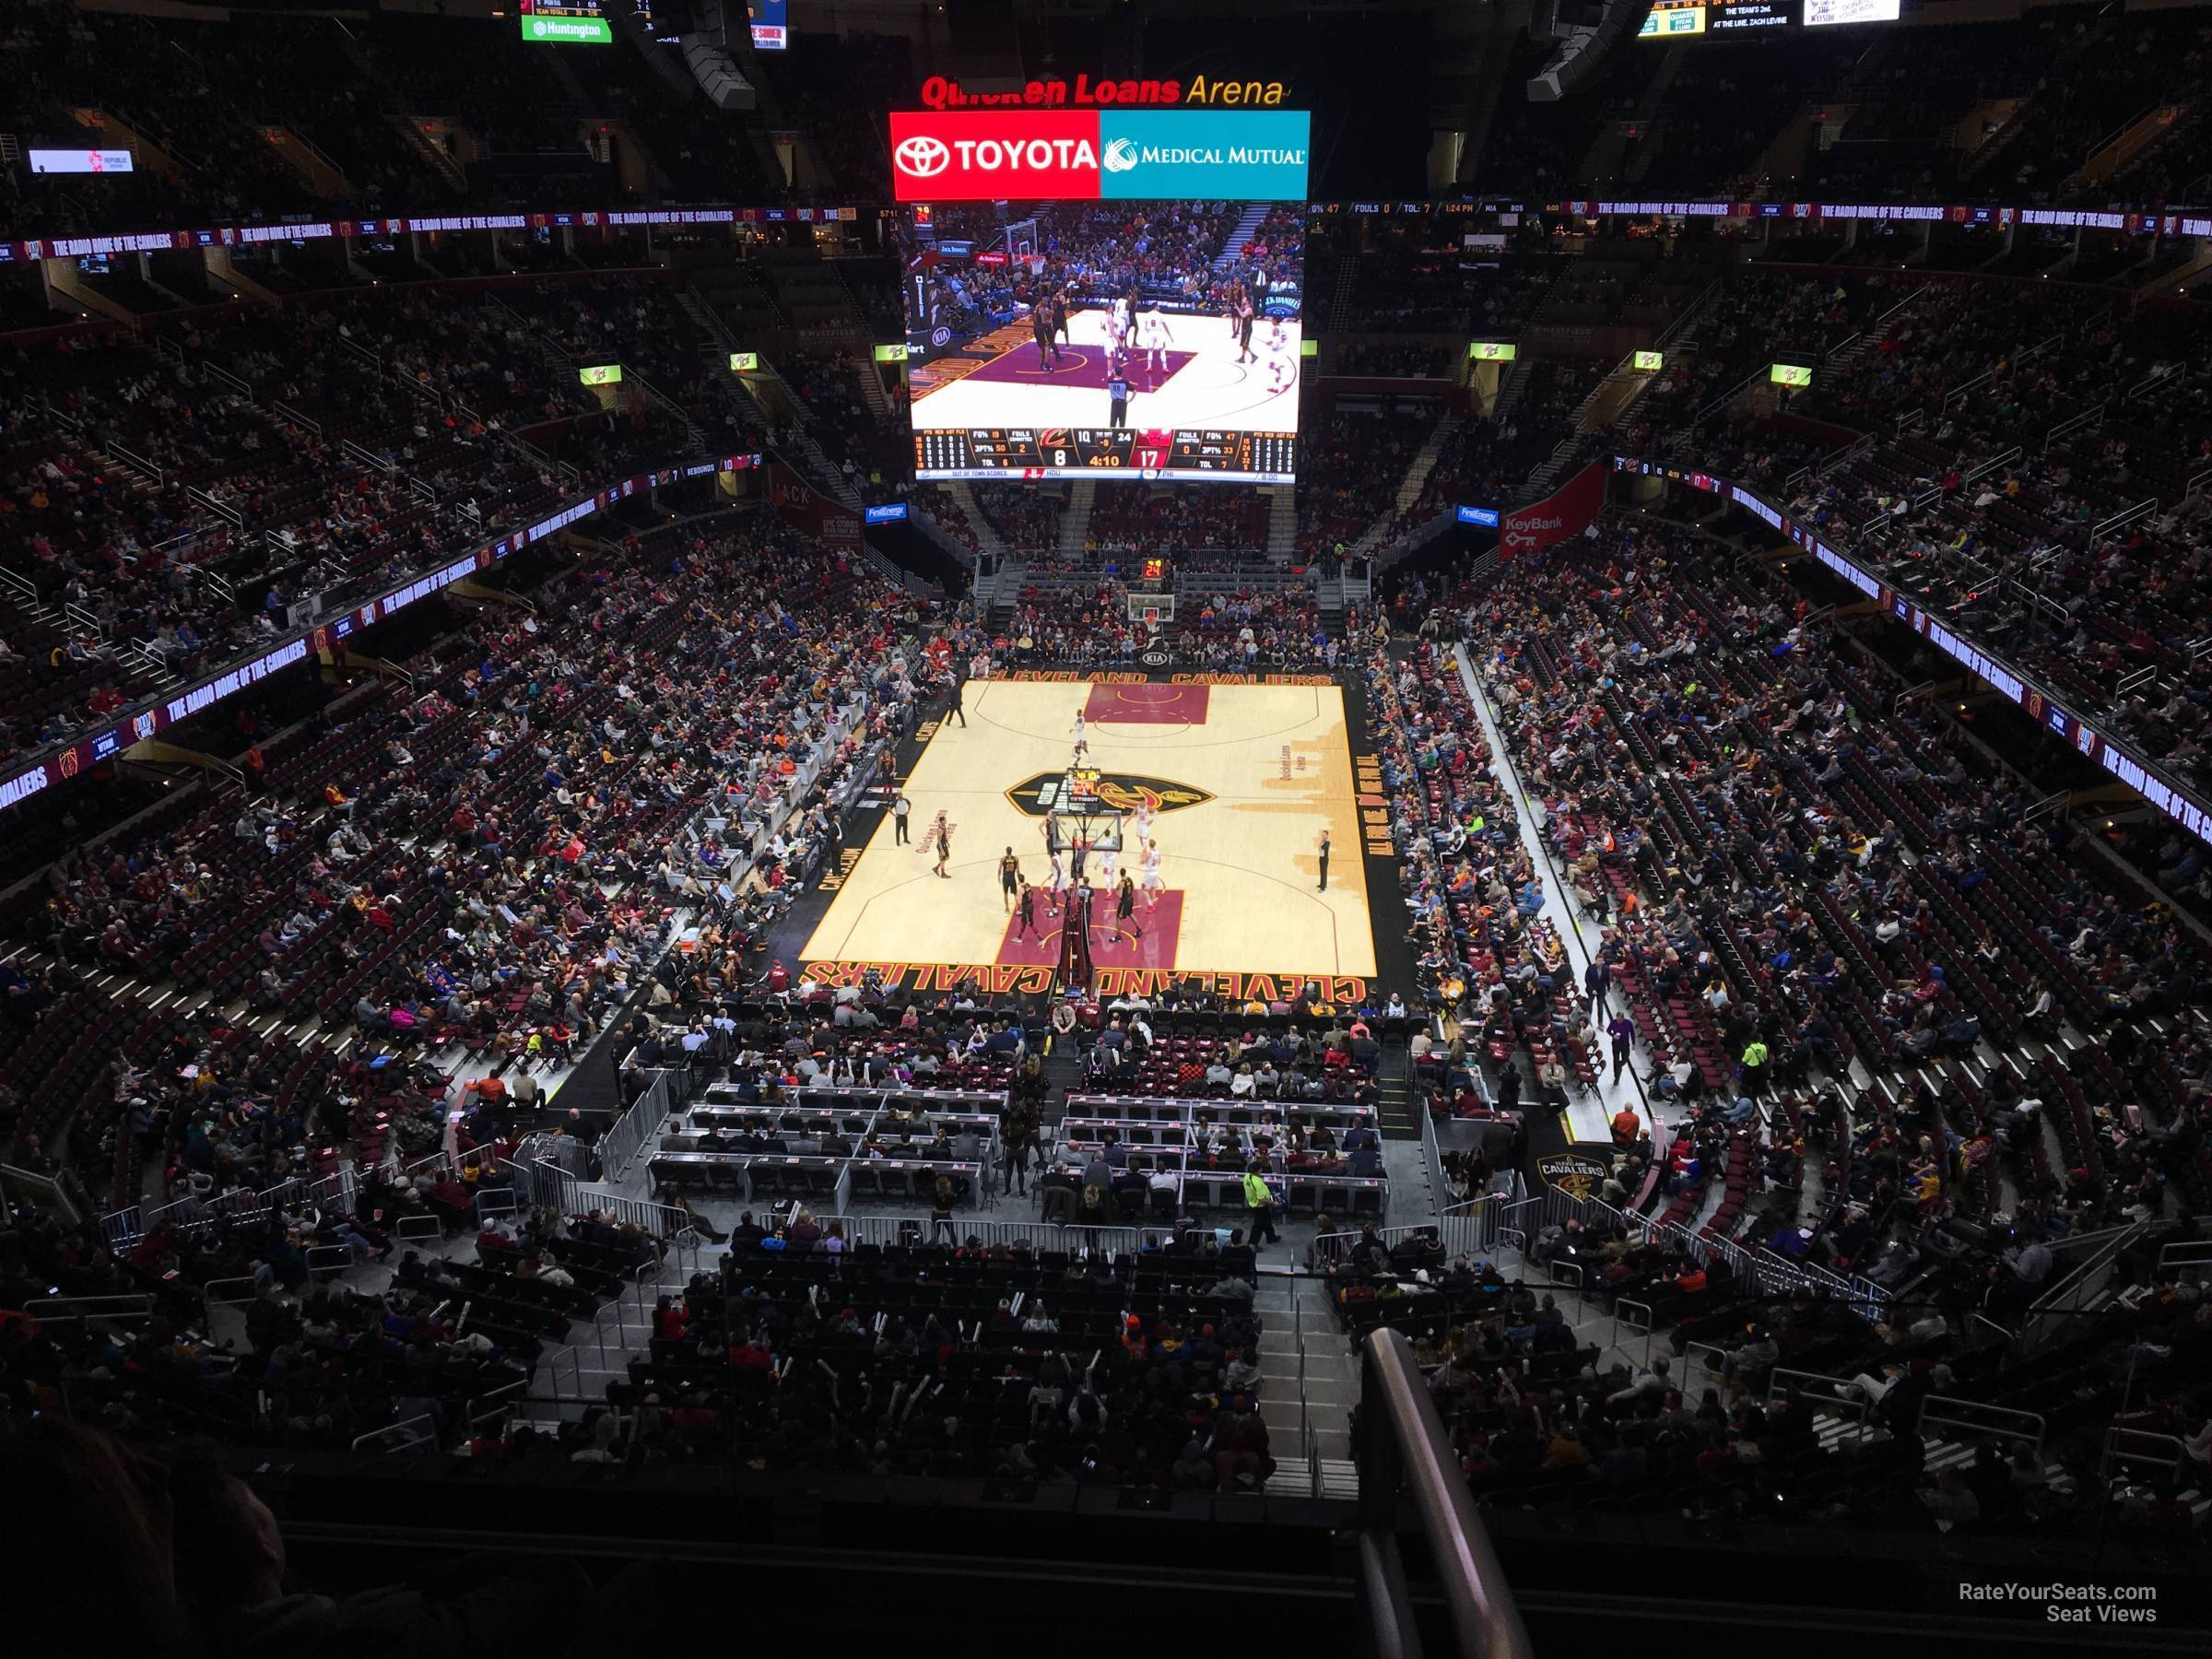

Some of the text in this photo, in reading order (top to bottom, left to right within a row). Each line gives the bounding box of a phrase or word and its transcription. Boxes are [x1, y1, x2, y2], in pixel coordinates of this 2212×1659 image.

[1670, 11, 1695, 20] QUAKER
[1750, 18, 1765, 26] ZACH
[1767, 16, 1787, 25] LEVINE
[547, 21, 600, 38] Huntington
[922, 74, 1283, 110] Quen Loans Arena
[954, 140, 1097, 170] TOYOTA
[1141, 146, 1302, 165] MEDICAL MUTUAL
[824, 209, 838, 220] THE
[1327, 204, 1339, 212] 47
[1355, 204, 1390, 213] FOULS 0
[1404, 204, 1430, 213] TOL: 7
[1599, 203, 1728, 215] THE RADIO HOME OF THE CAVALIERS
[1821, 205, 1943, 219] THE RADIO HOME OF THE CAVALIERS
[409, 216, 525, 231] THE RADIO HOME OF THE CAVALIERS
[608, 211, 733, 223] THE RADIO HOME OF THE CAVALIERS
[53, 234, 172, 256] THE RADIO HOME OF THE CAVALIERS
[1078, 431, 1090, 443] 1Q
[1118, 433, 1131, 441] 24
[1019, 444, 1025, 453] 2
[1183, 445, 1190, 453] 0
[1055, 450, 1066, 466] 8
[1090, 456, 1119, 466] 4:10
[1141, 451, 1158, 467] 17
[673, 460, 732, 481] 7 REBOUNDS 10
[1643, 463, 1648, 474] 8
[1695, 475, 1701, 487] 17
[869, 507, 904, 516] FirstEnergy
[1462, 508, 1496, 522] FirstEnergy
[1506, 516, 1562, 532] KeyBank
[1146, 566, 1160, 576] 24
[168, 639, 306, 722] THE RADIO HOME OF THE CAVALIERS
[988, 671, 1331, 686] CLEVELAND CAVALIERS
[1280, 745, 1291, 781] Quicken Loans
[1295, 757, 1305, 771] Arena
[2103, 744, 2119, 774] THE
[2117, 755, 2145, 792] RADIO
[2144, 773, 2172, 811] HOME
[2170, 793, 2184, 819] OF
[2183, 801, 2202, 834] THE
[915, 828, 938, 854] Quicken
[1542, 1165, 1604, 1177] CAVALIERS
